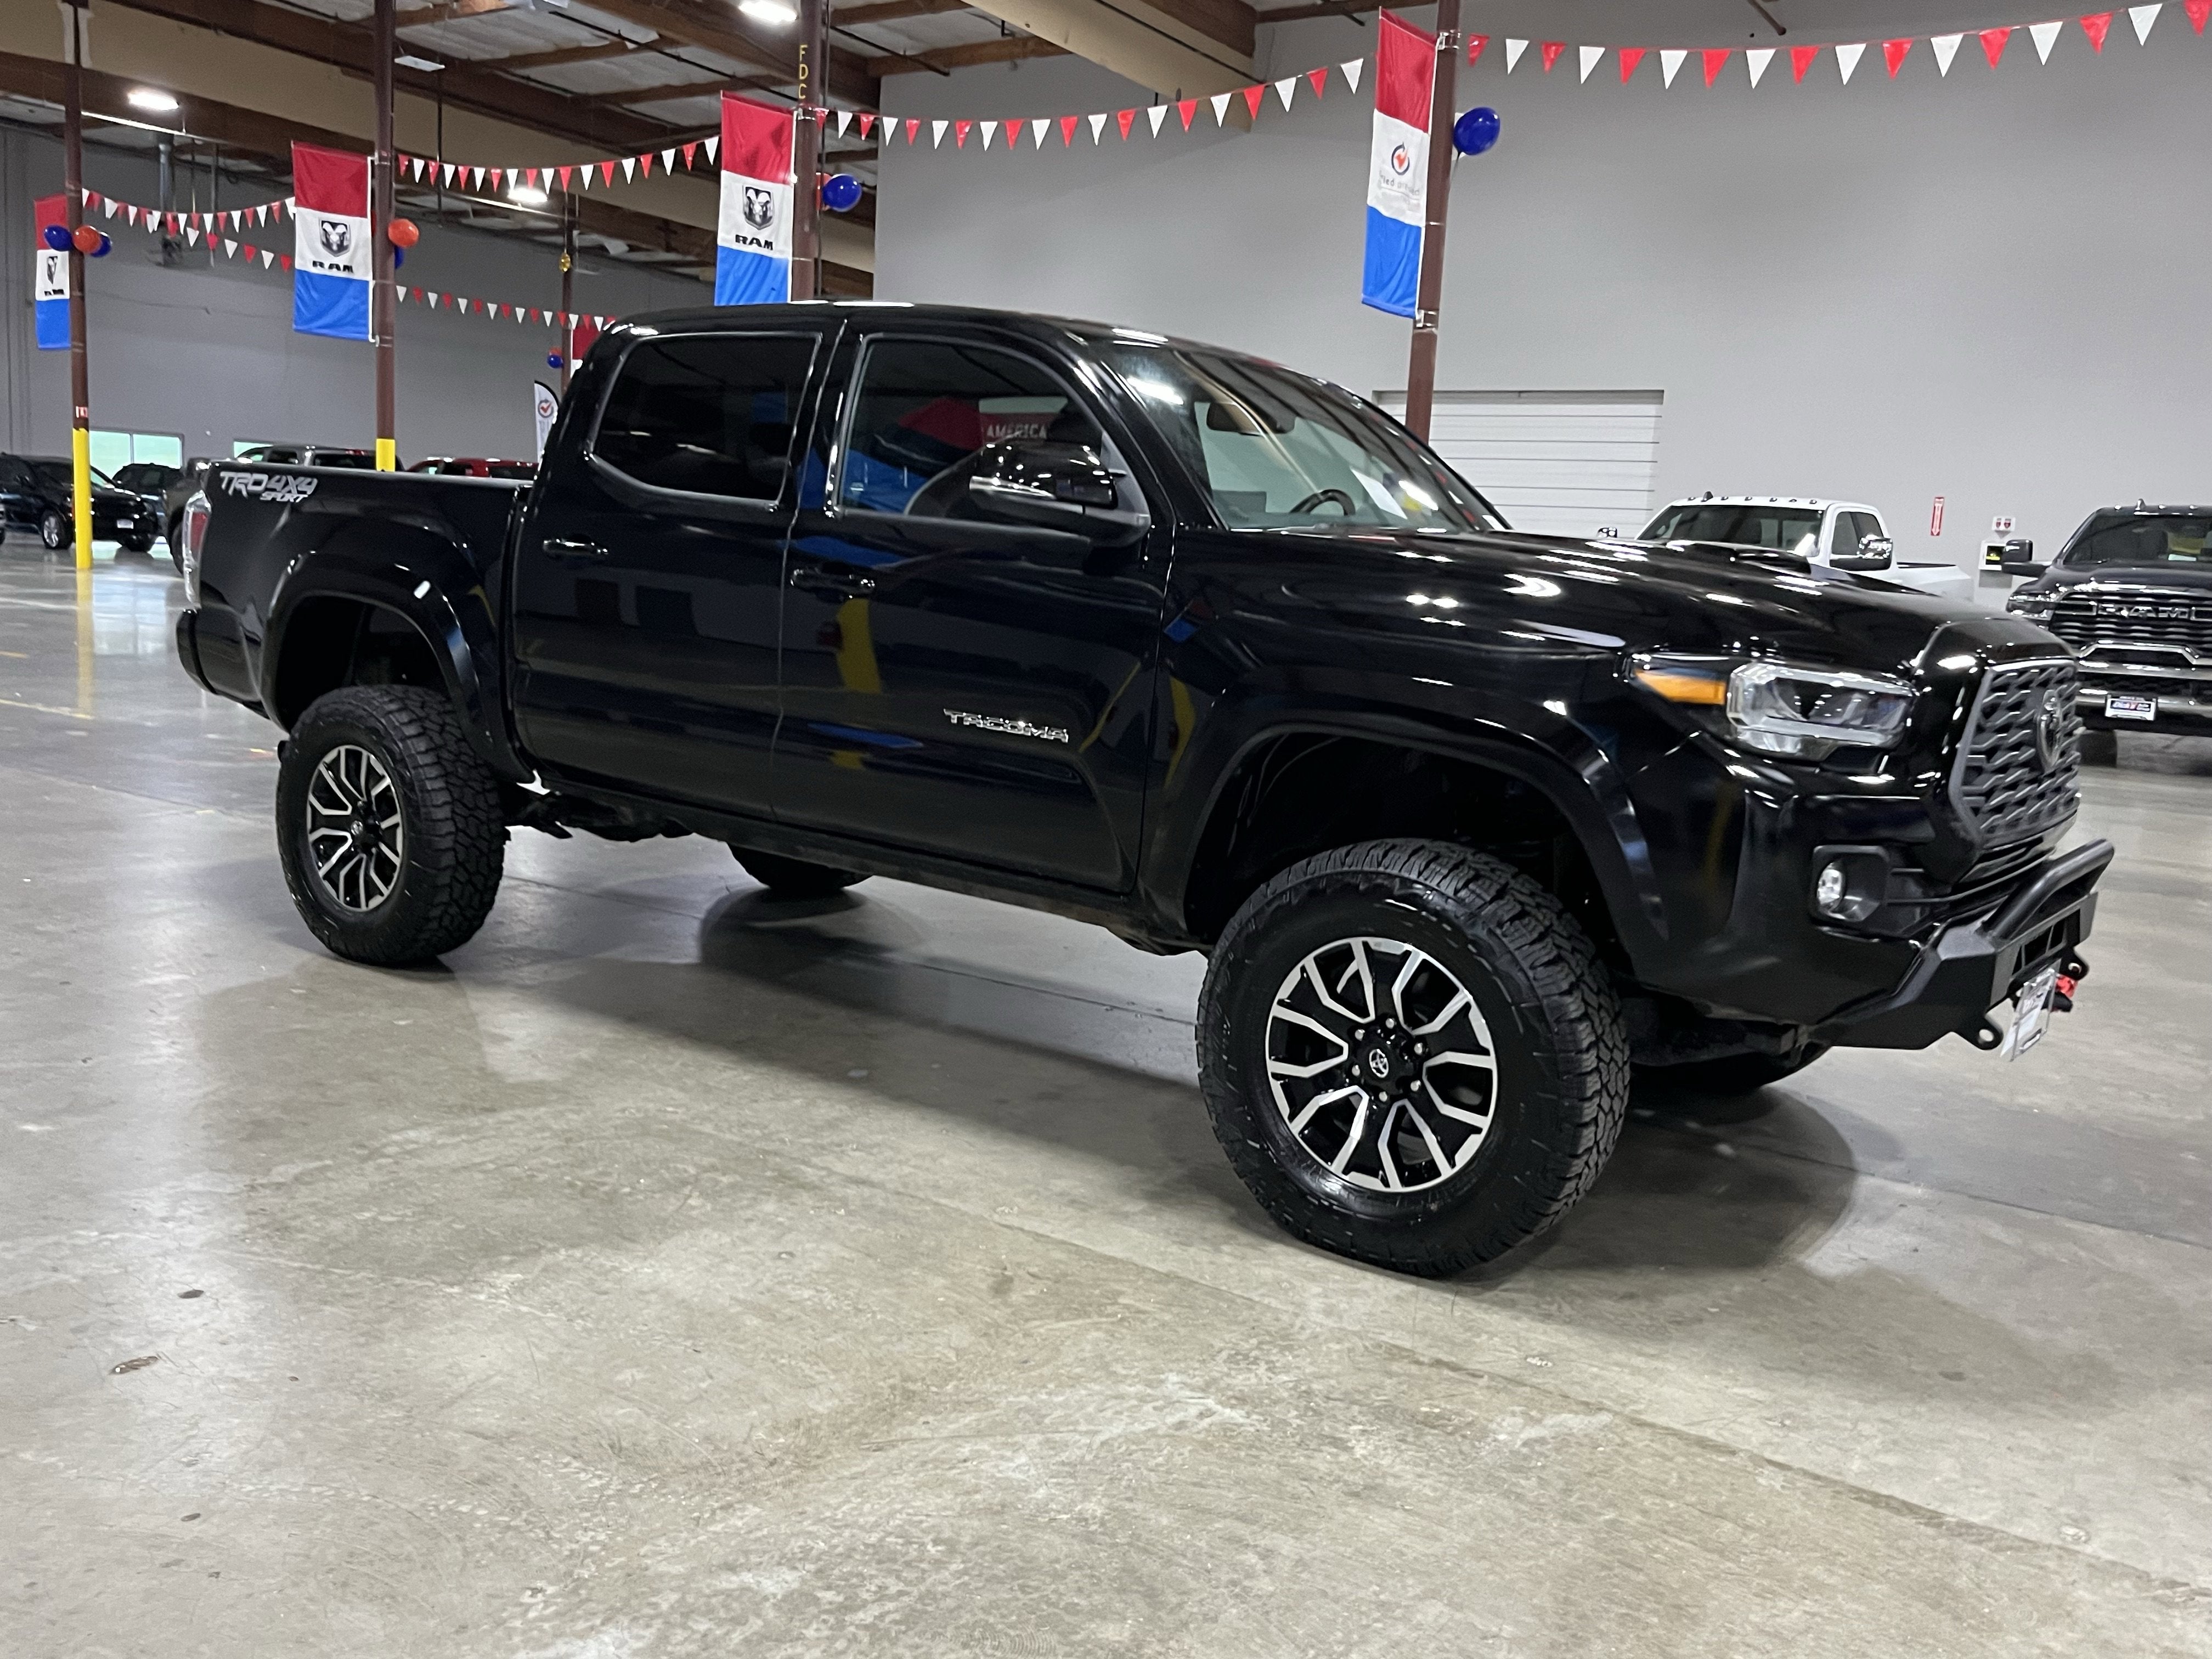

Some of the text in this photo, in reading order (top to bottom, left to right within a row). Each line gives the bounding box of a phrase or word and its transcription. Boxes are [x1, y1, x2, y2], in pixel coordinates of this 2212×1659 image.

[798, 44, 809, 99] FDC
[735, 234, 773, 251] RAM
[312, 260, 353, 273] RAM
[220, 471, 269, 498] TRD
[259, 492, 308, 503] SPORT
[2097, 603, 2190, 619] RAM
[944, 708, 1069, 743] TACOMA
